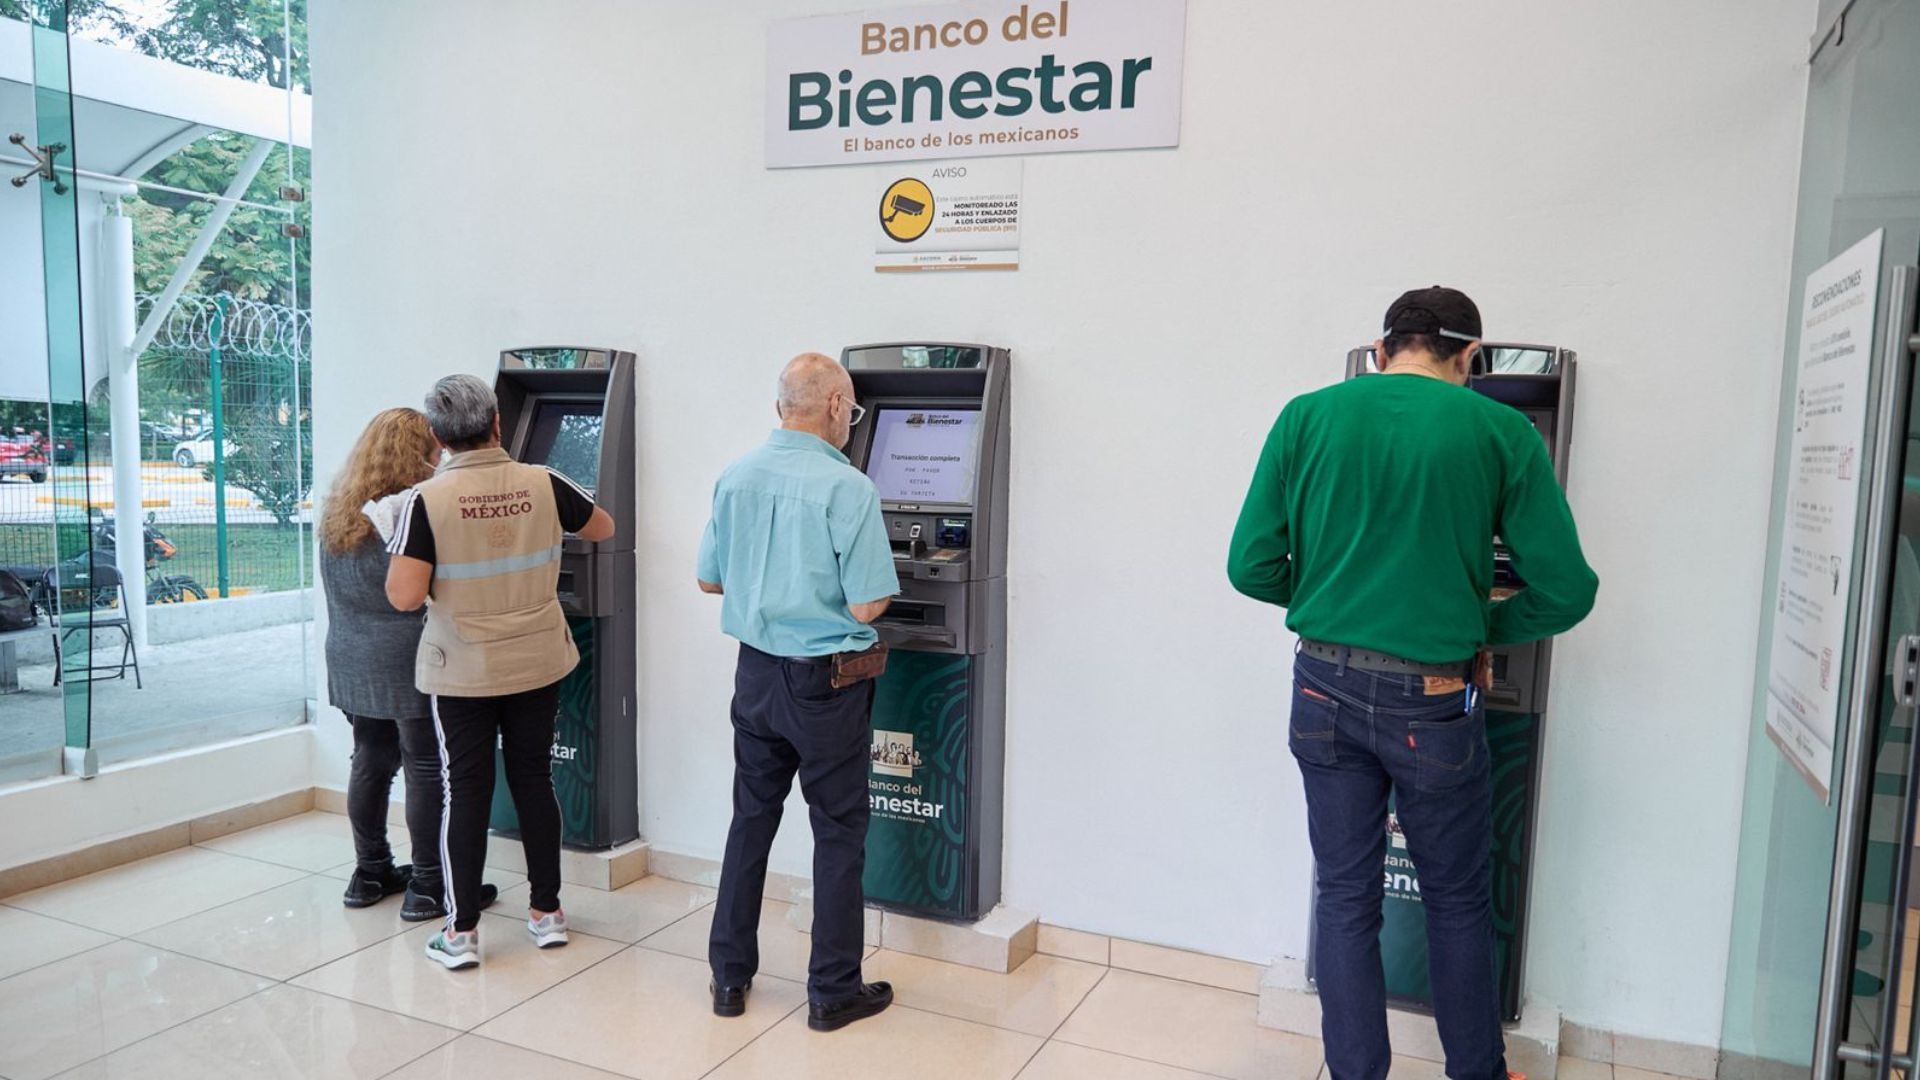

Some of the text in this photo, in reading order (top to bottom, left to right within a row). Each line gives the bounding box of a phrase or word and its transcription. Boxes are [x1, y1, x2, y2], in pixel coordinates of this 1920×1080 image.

[861, 0, 1068, 56] Banco del
[788, 54, 1152, 131] Bienestar
[843, 126, 1080, 153] El banco de los mexicanos
[932, 167, 967, 178] AVISO
[458, 490, 530, 504] GOBIERNO DE
[460, 501, 532, 519] MÉXICO
[868, 779, 922, 795] anco del
[869, 794, 943, 818] nestar
